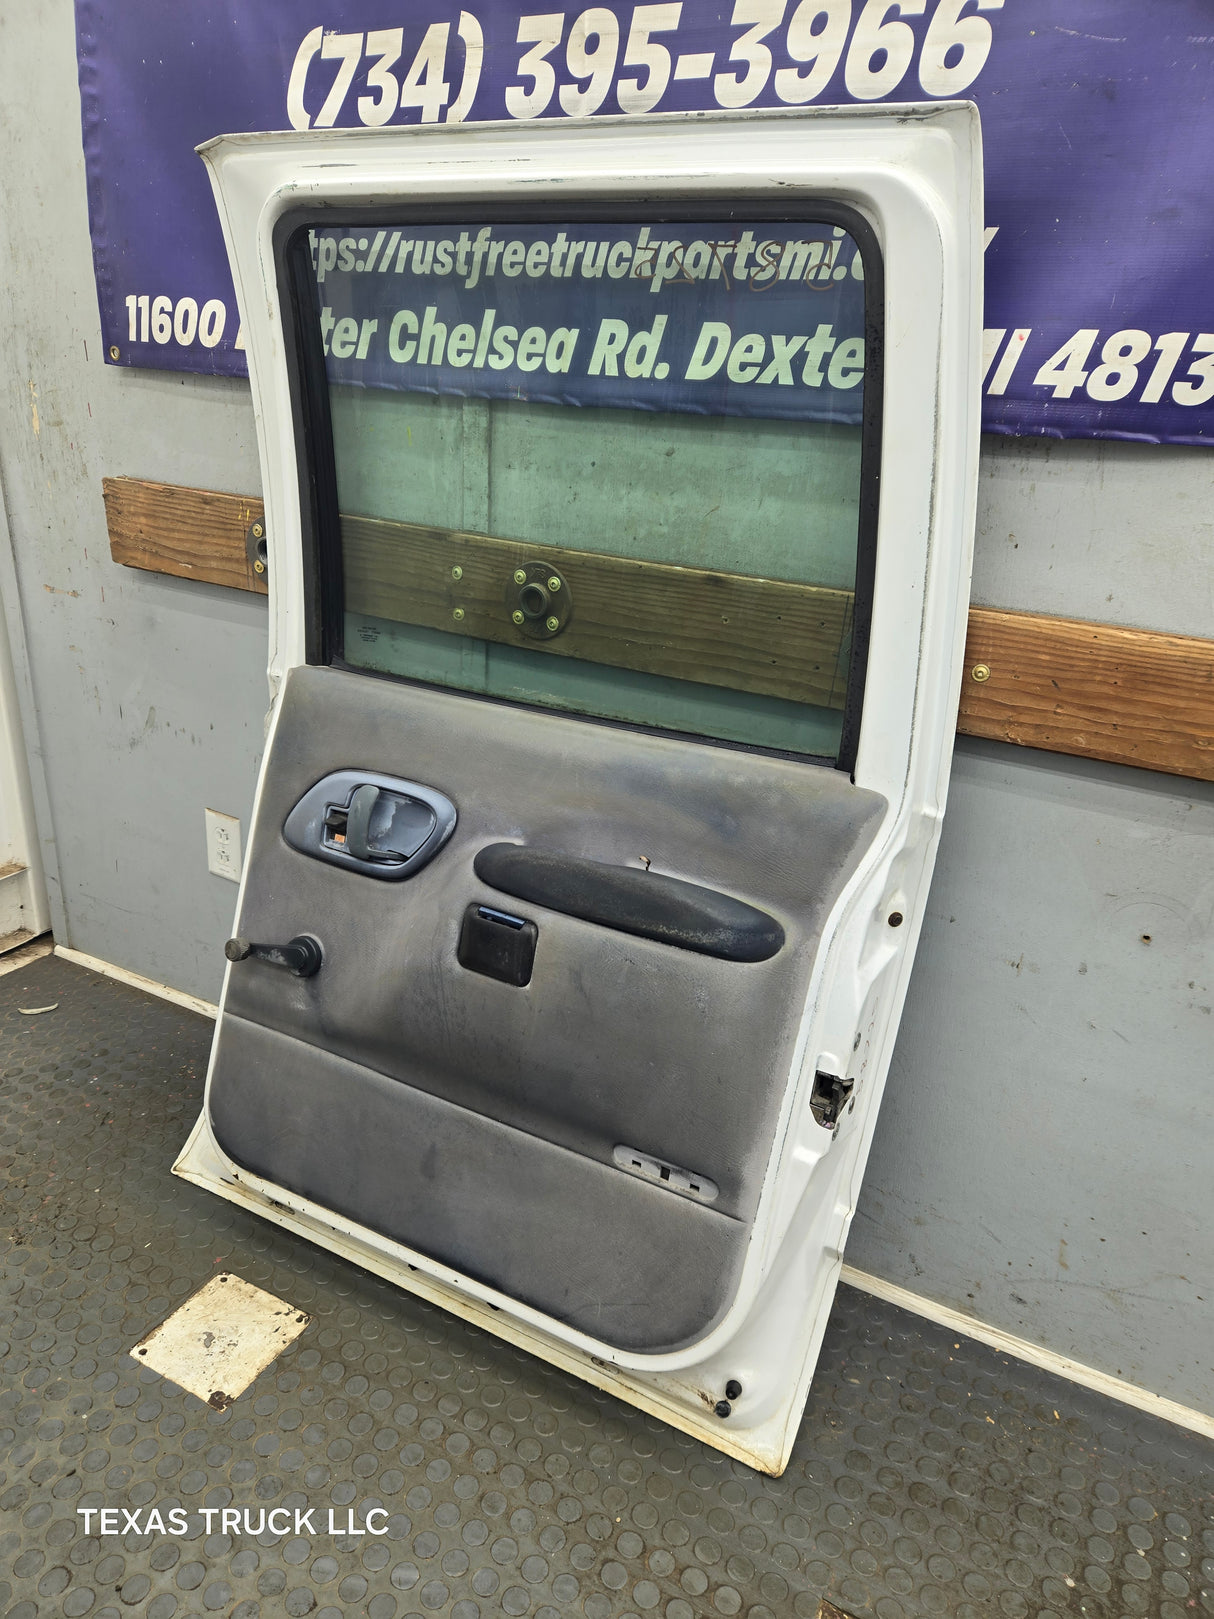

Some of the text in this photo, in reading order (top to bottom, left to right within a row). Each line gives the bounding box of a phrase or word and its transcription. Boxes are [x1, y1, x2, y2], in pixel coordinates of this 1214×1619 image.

[287, 0, 1003, 130] (734) 395-3966
[125, 294, 227, 348] 11600
[388, 306, 580, 375] Chelsea
[587, 314, 670, 380] Rd.
